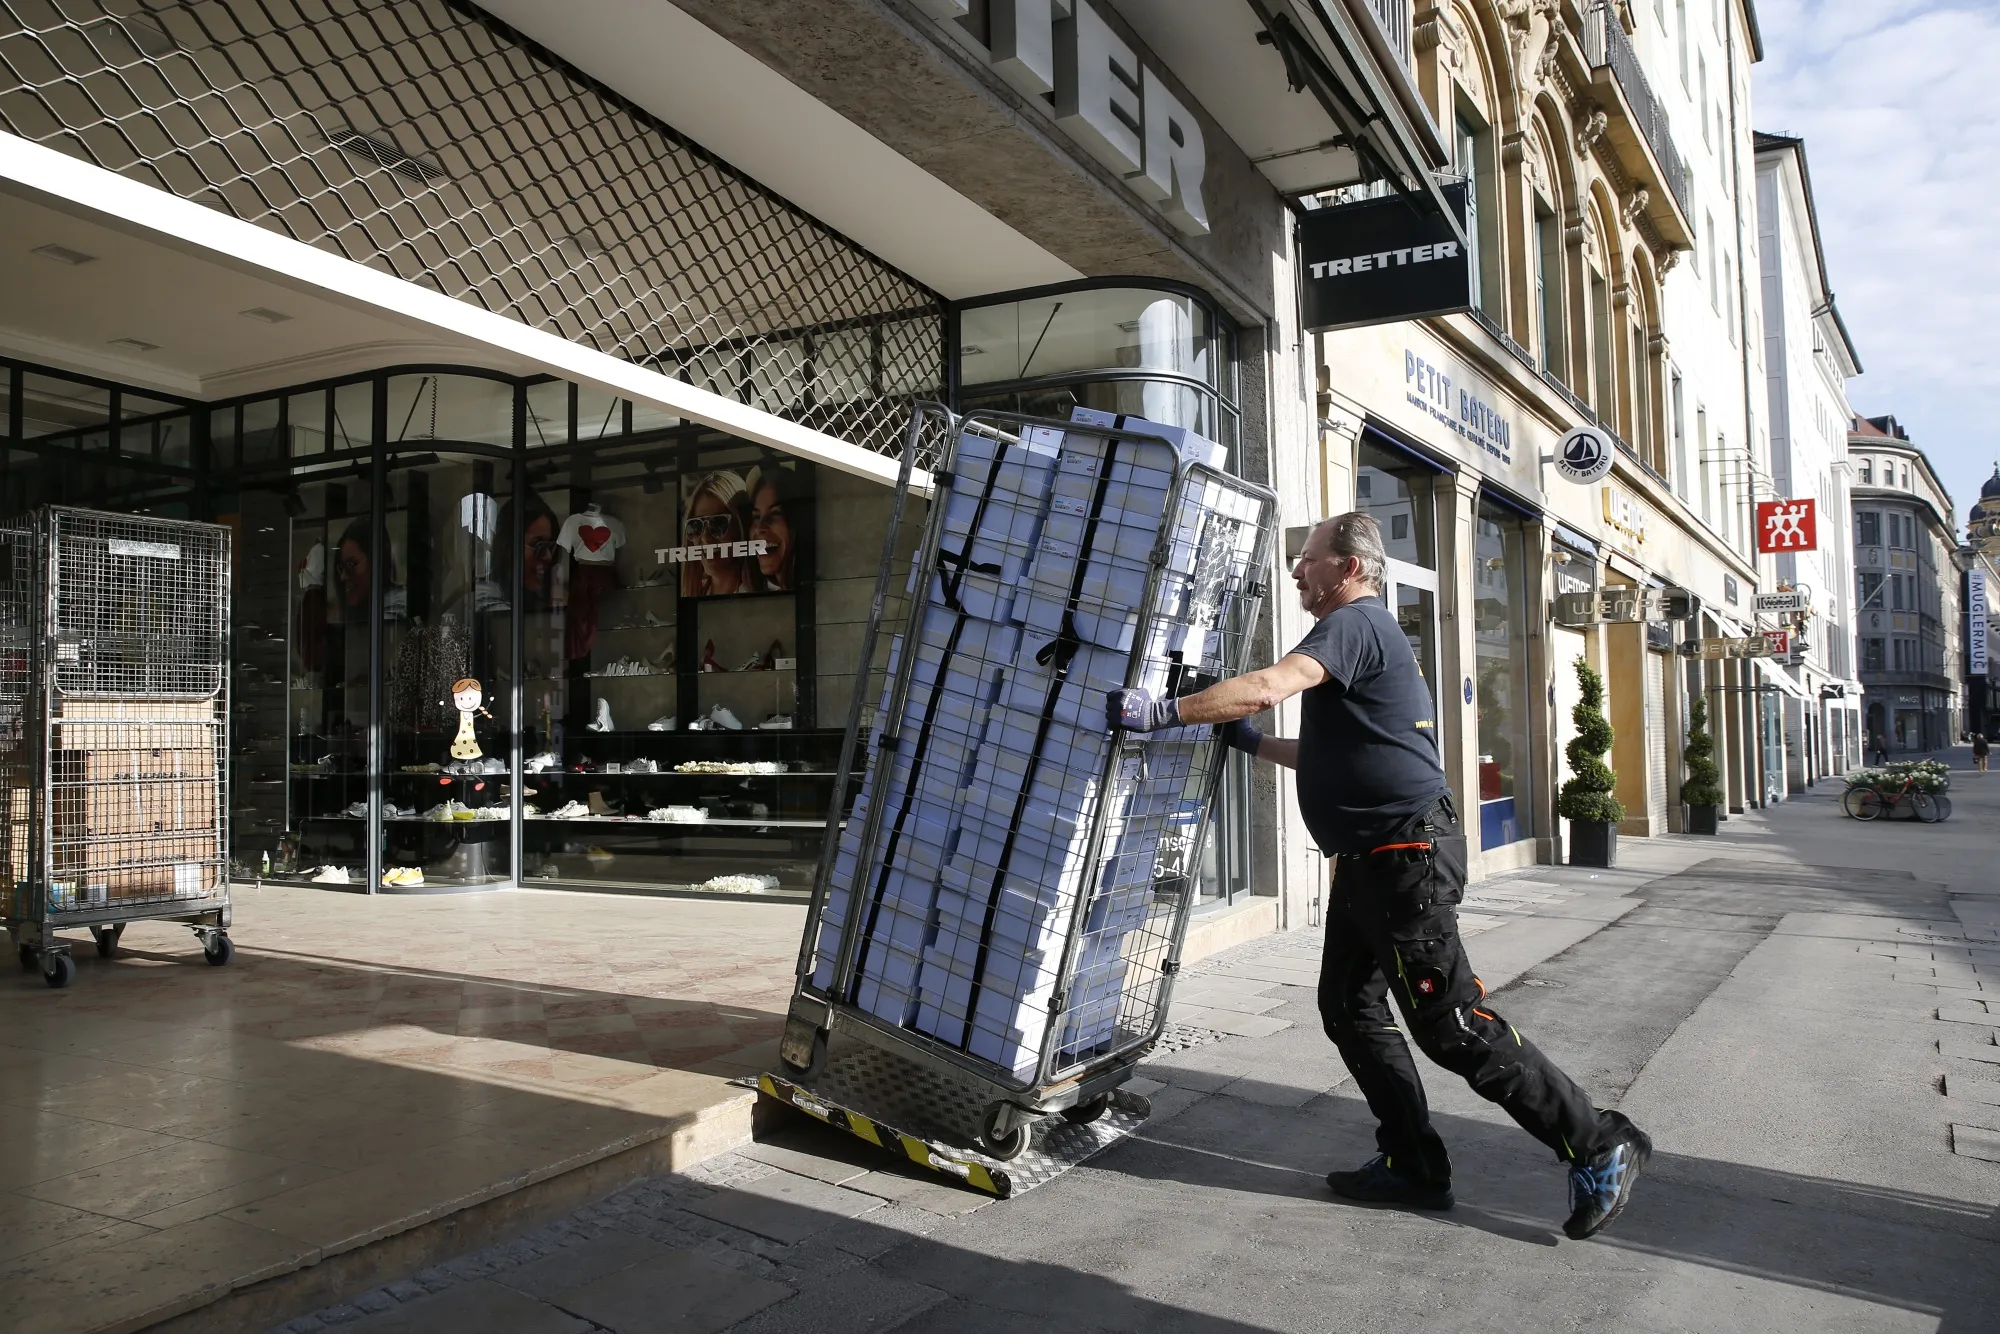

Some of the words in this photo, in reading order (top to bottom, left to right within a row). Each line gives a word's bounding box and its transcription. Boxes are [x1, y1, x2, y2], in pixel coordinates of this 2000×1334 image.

[1309, 241, 1459, 279] TRETTER
[1405, 349, 1451, 410] PETIT
[1460, 388, 1511, 450] BATEAU
[1558, 459, 1578, 477] PETIT
[1581, 455, 1608, 477] BATEAU
[654, 540, 768, 564] TRETTER
[1573, 597, 1671, 615] WEMPE
